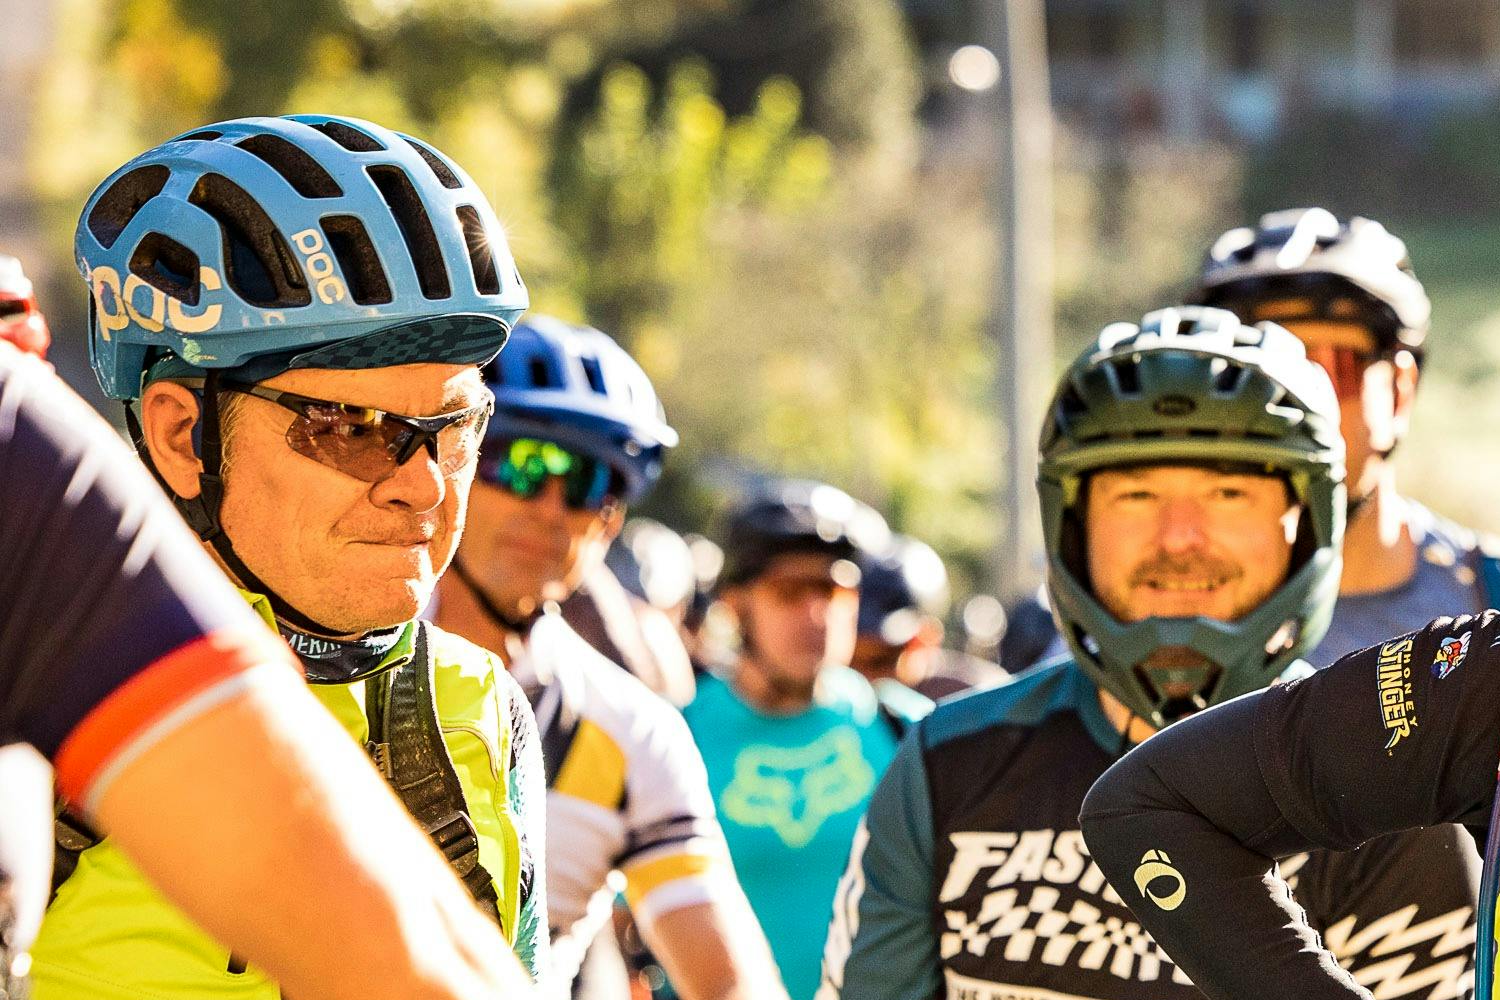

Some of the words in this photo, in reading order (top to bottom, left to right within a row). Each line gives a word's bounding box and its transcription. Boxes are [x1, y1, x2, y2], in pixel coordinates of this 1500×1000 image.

[1378, 638, 1413, 749] STINGER
[1403, 653, 1418, 727] HONEY
[939, 829, 1128, 907] FAS
